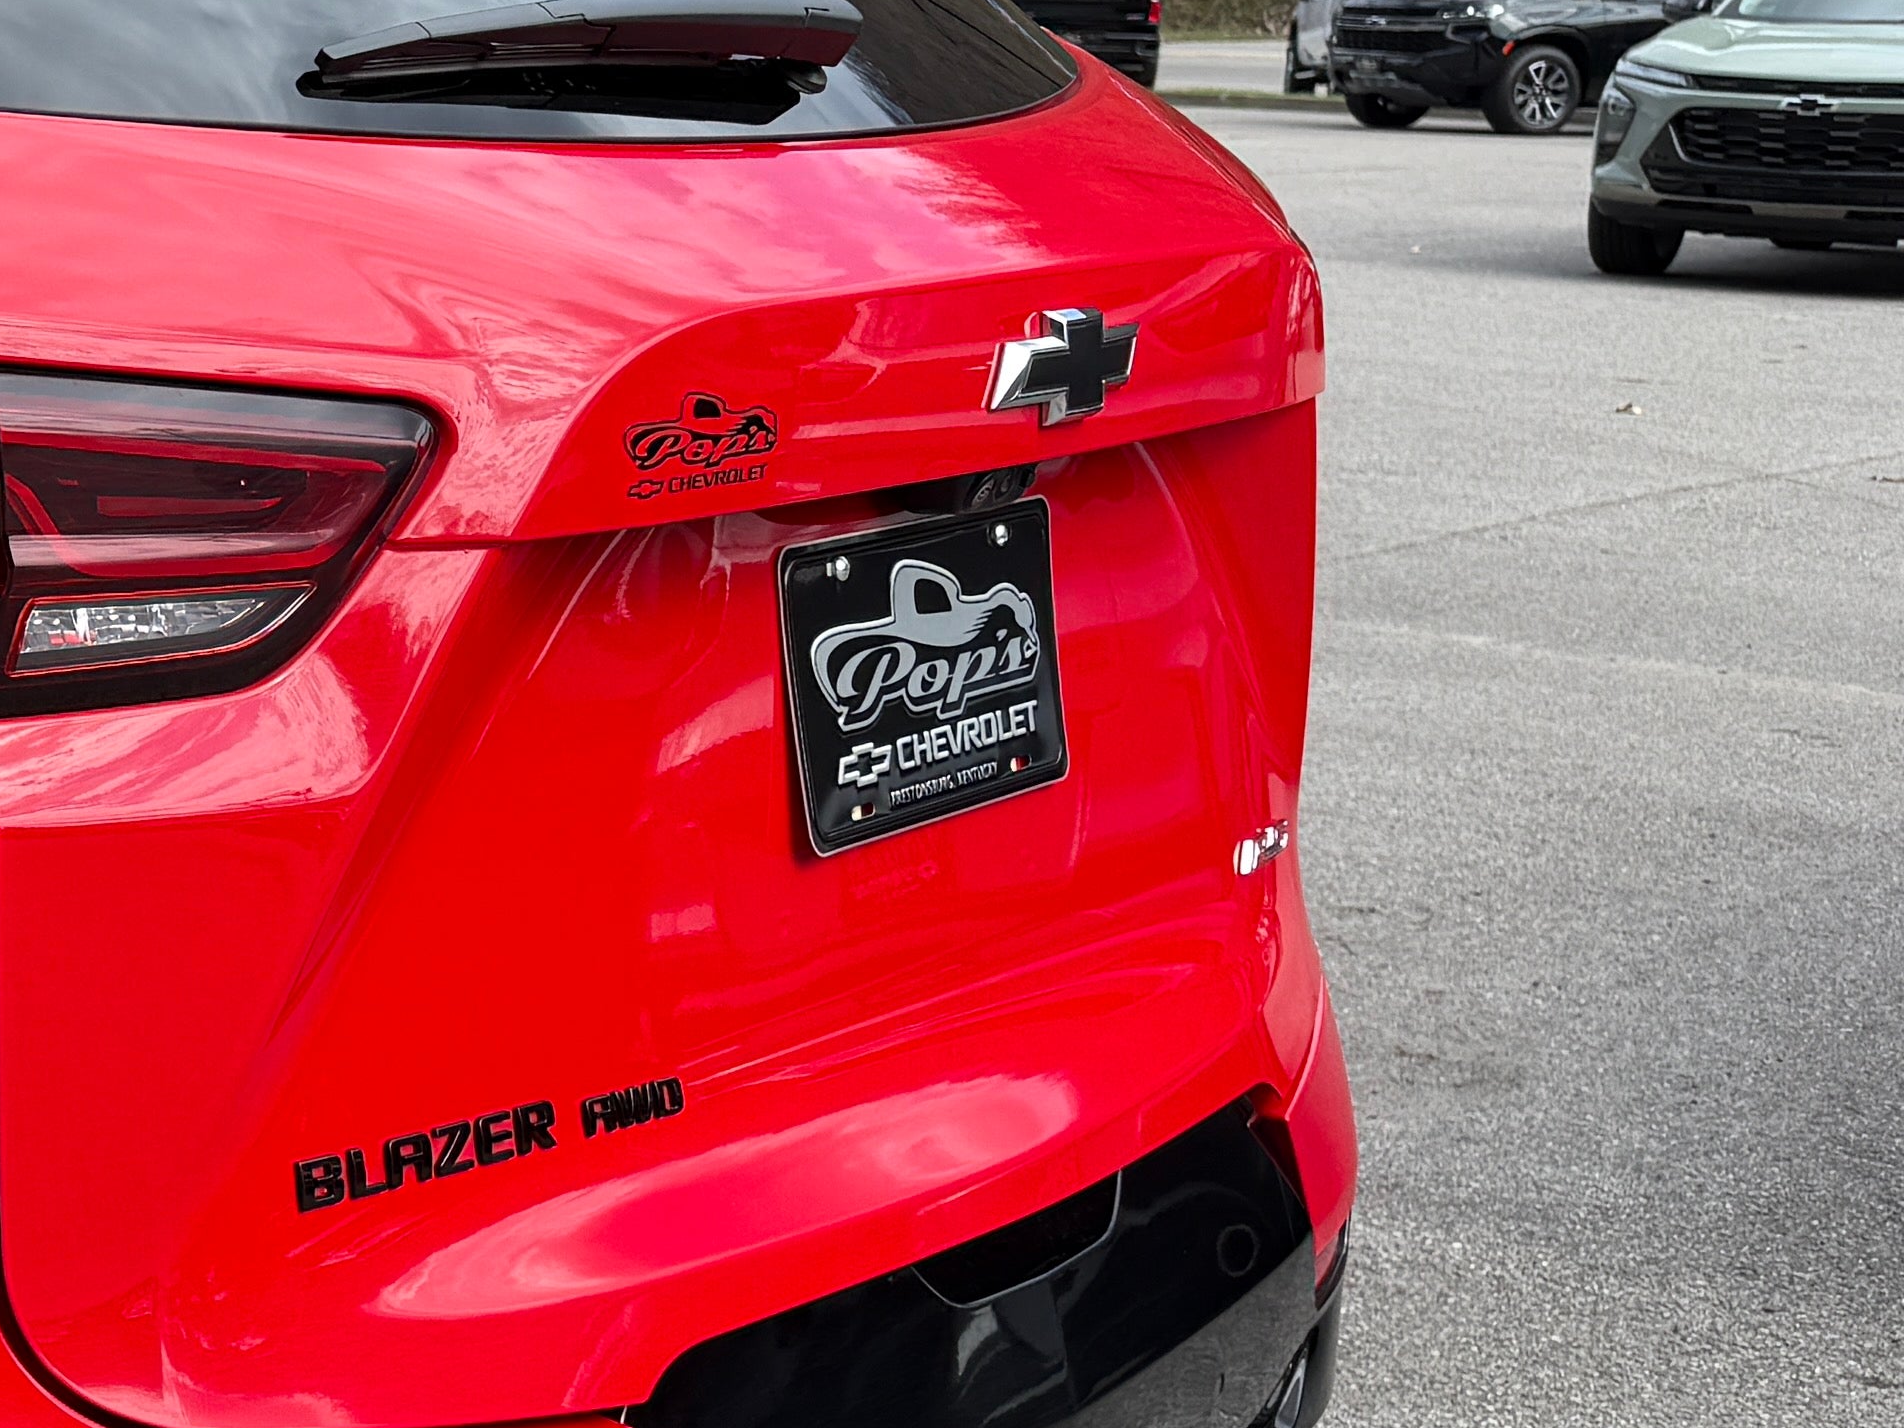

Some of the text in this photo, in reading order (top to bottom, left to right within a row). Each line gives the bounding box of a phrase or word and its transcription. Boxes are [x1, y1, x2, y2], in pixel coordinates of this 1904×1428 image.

[635, 425, 772, 467] Pop's
[668, 463, 769, 494] CHEVROLET
[836, 627, 1031, 715] Pop's
[895, 699, 1038, 771] CHEVROLET
[297, 1076, 685, 1214] BLAZER AWD
